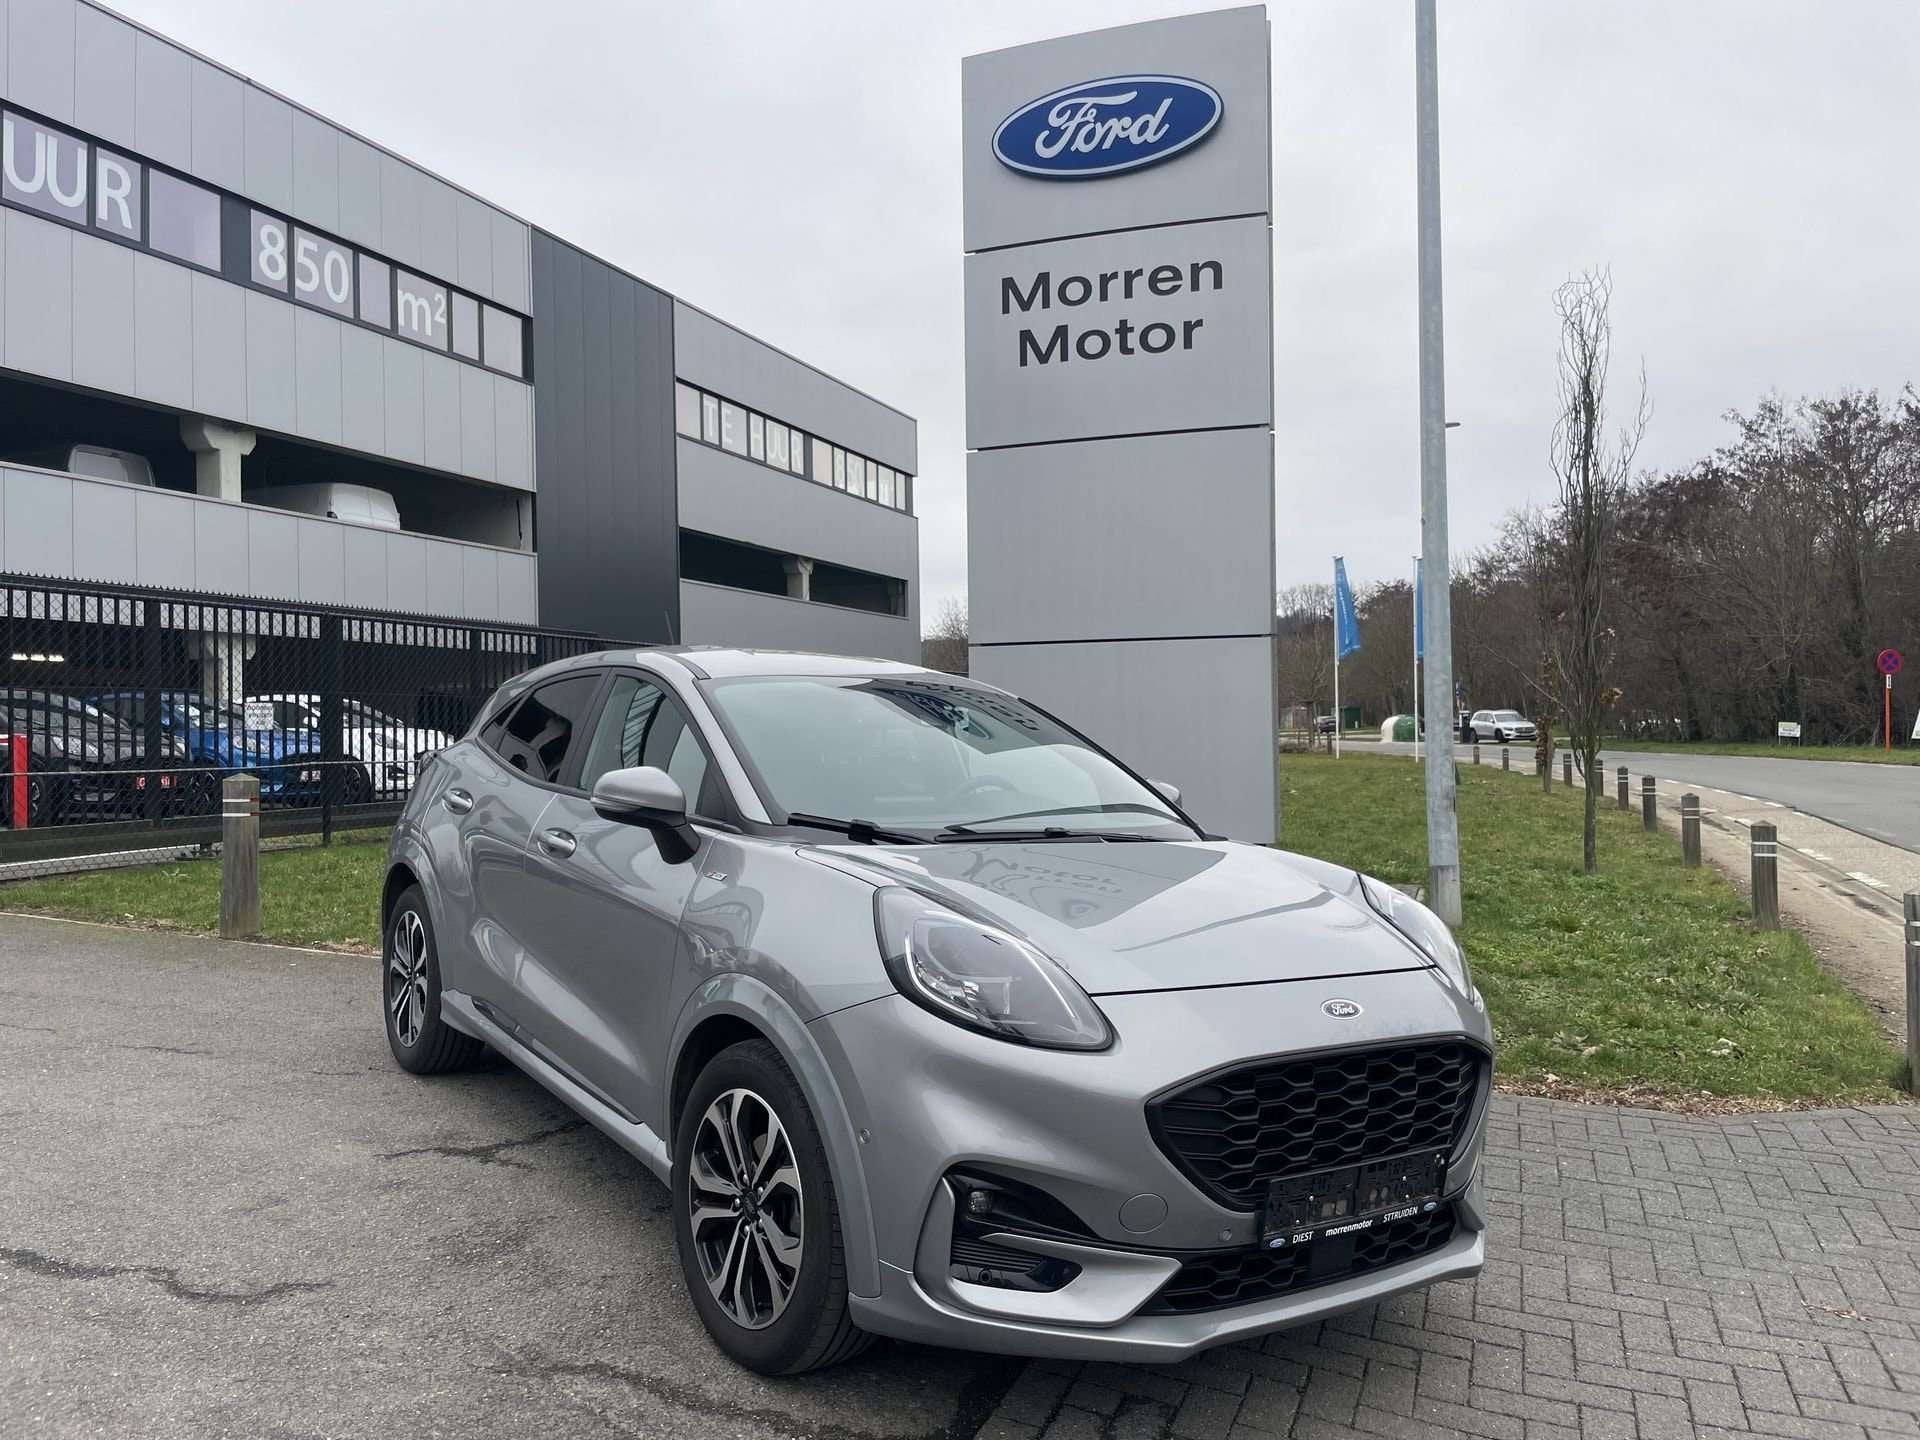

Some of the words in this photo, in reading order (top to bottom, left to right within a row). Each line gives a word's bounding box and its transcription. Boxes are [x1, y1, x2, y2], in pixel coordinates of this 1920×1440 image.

[1035, 91, 1173, 158] Ford
[3, 119, 132, 229] UUR
[259, 224, 349, 303] 850
[1001, 258, 1223, 315] Morren
[1019, 318, 1203, 367] Motor
[704, 400, 733, 444] TE
[751, 416, 802, 468] HUUR
[1331, 1003, 1355, 1015] Ford
[1292, 1231, 1314, 1244] DIEST
[1325, 1219, 1373, 1237] morrenmotor
